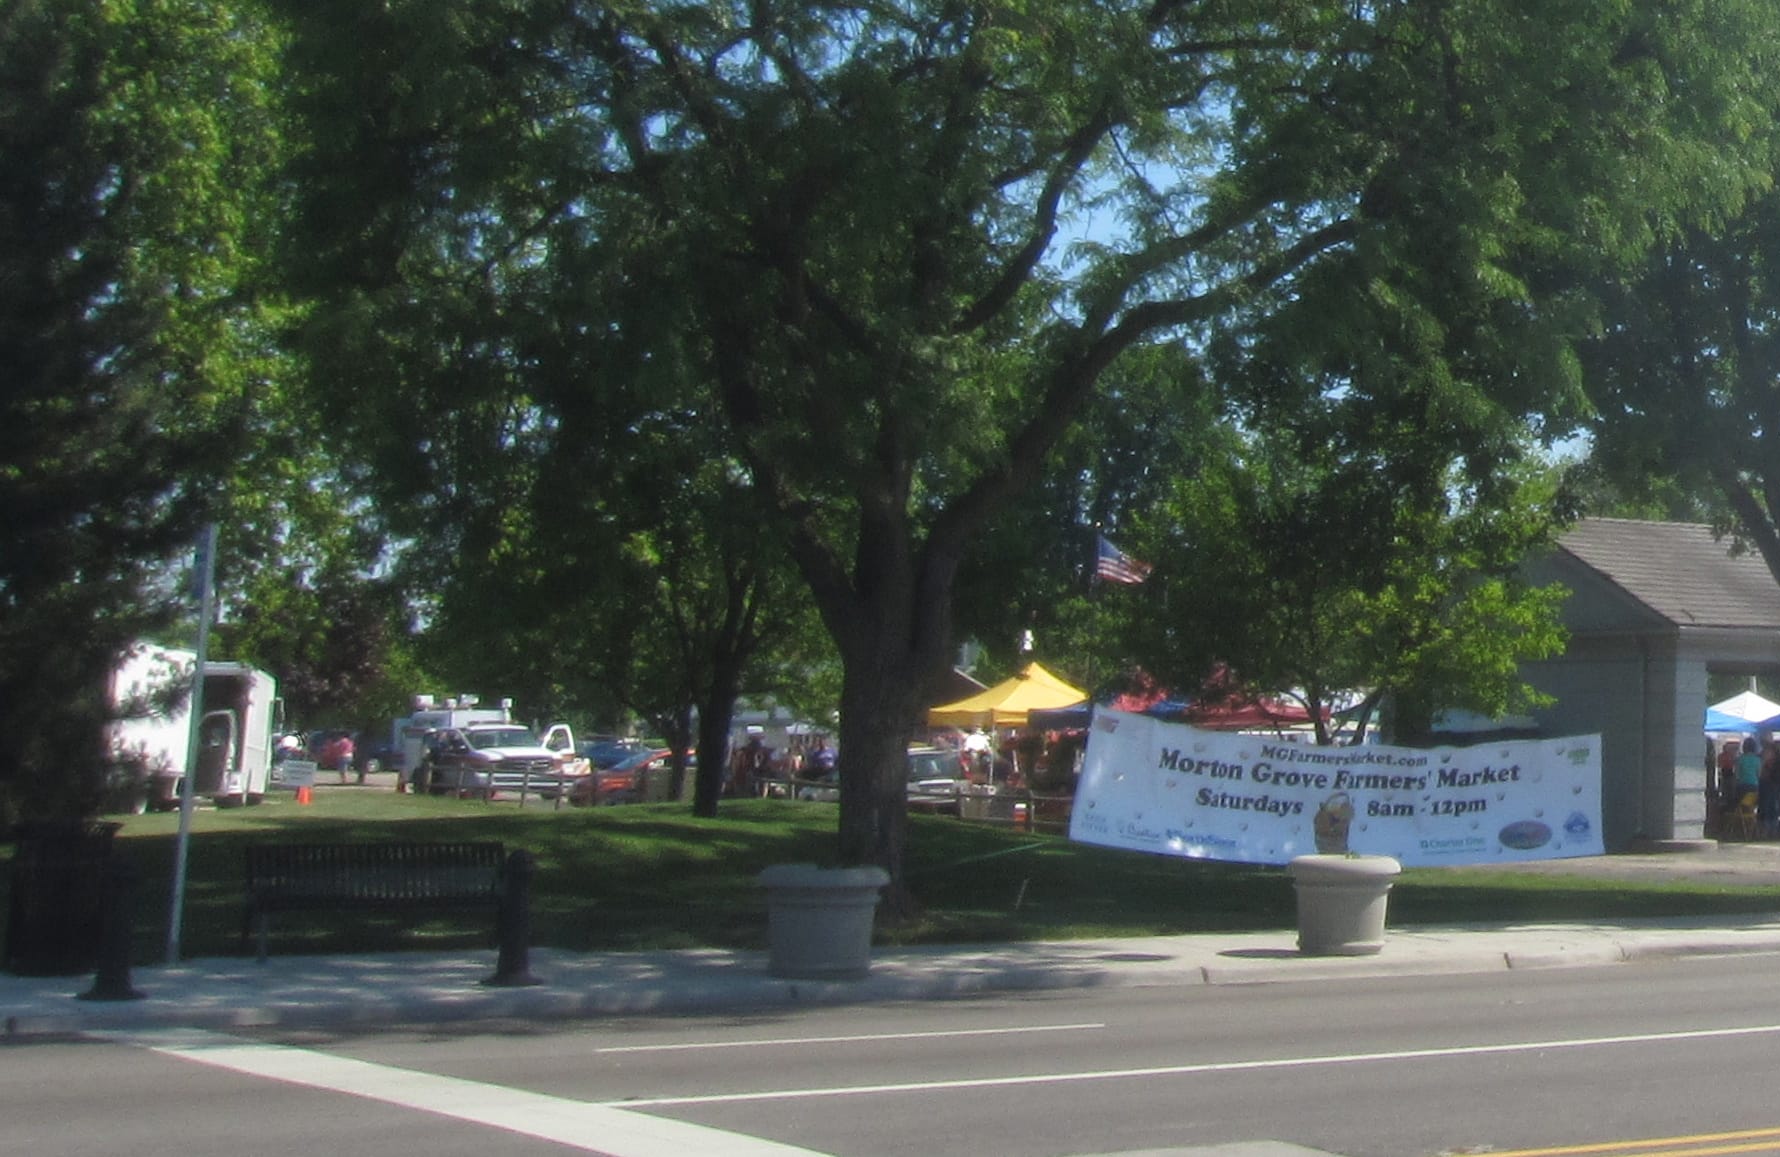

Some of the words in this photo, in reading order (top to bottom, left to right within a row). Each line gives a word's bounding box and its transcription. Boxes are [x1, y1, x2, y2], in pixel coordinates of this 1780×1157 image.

[1158, 747, 1243, 781] Morton
[1251, 762, 1328, 790] Grove
[1435, 764, 1520, 789] Market
[1195, 788, 1303, 817] Saturdays
[1367, 800, 1414, 817] 8am
[1430, 797, 1487, 817] 12pm
